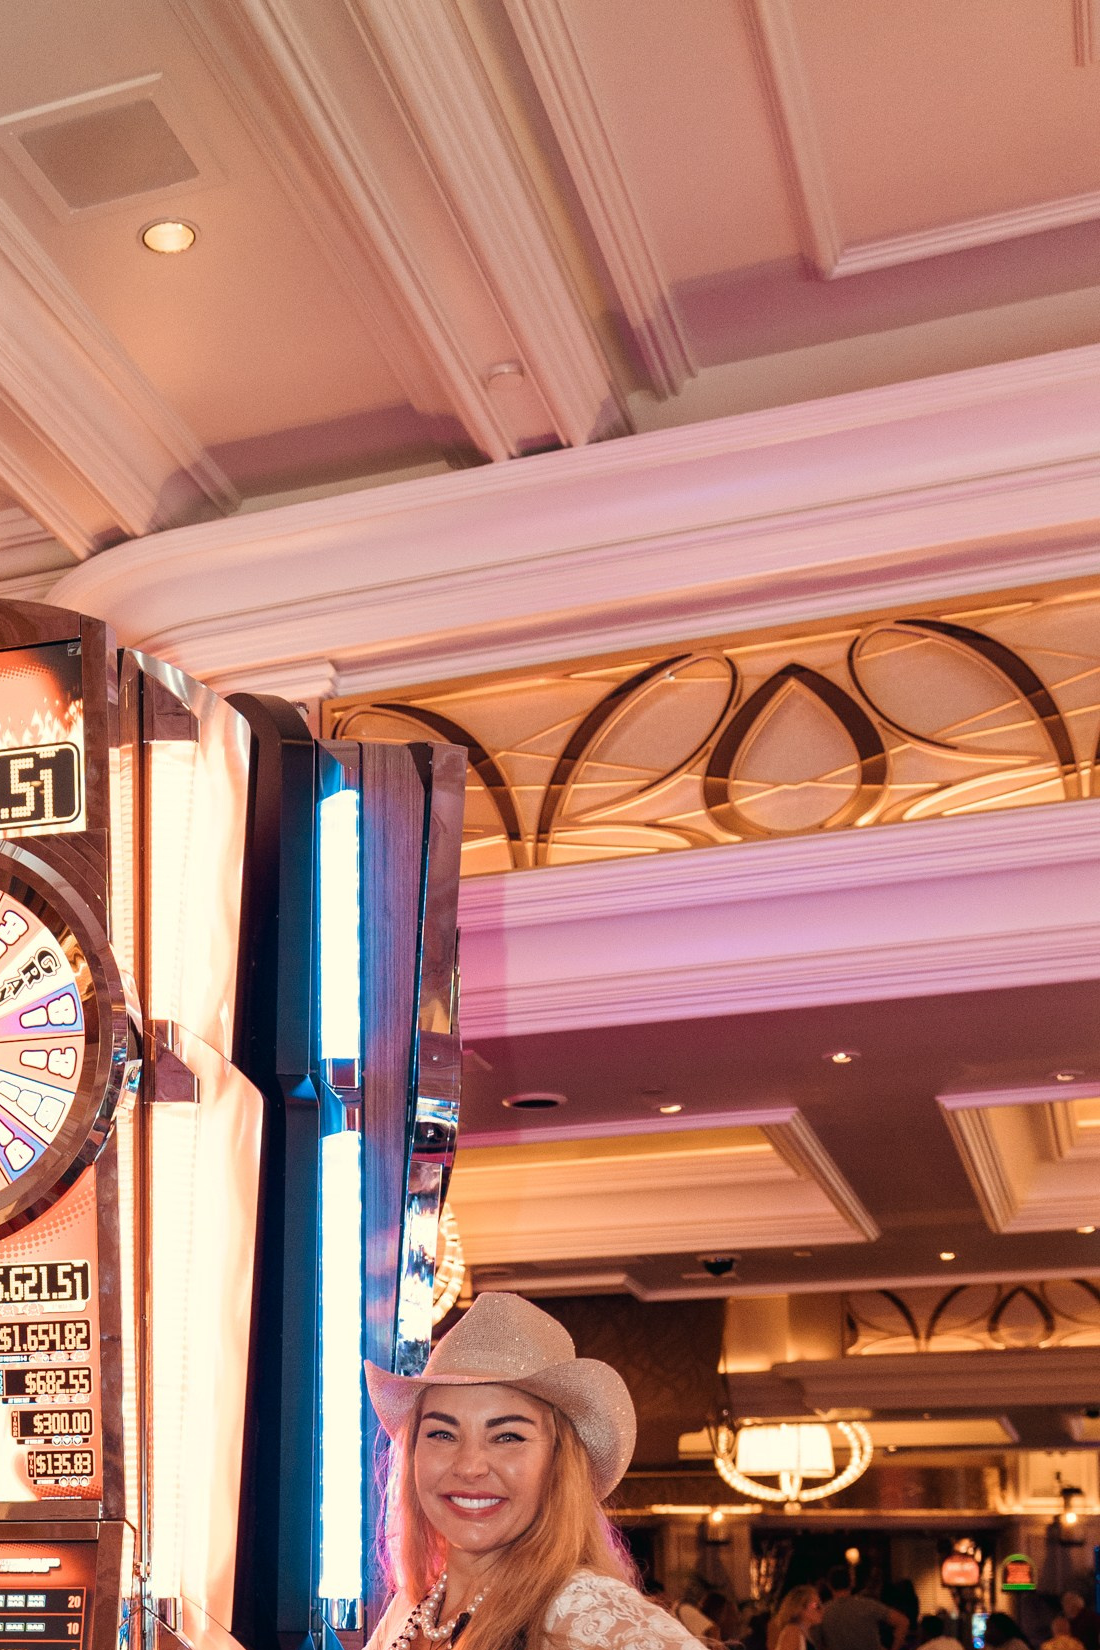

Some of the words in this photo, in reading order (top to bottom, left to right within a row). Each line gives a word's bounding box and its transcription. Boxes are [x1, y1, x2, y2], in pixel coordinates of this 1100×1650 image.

[25, 1370, 89, 1394] $682.55
[33, 1412, 90, 1434] $300.00
[36, 1453, 91, 1474] $135.83
[68, 1596, 82, 1608] 20
[66, 1622, 80, 1635] 10
